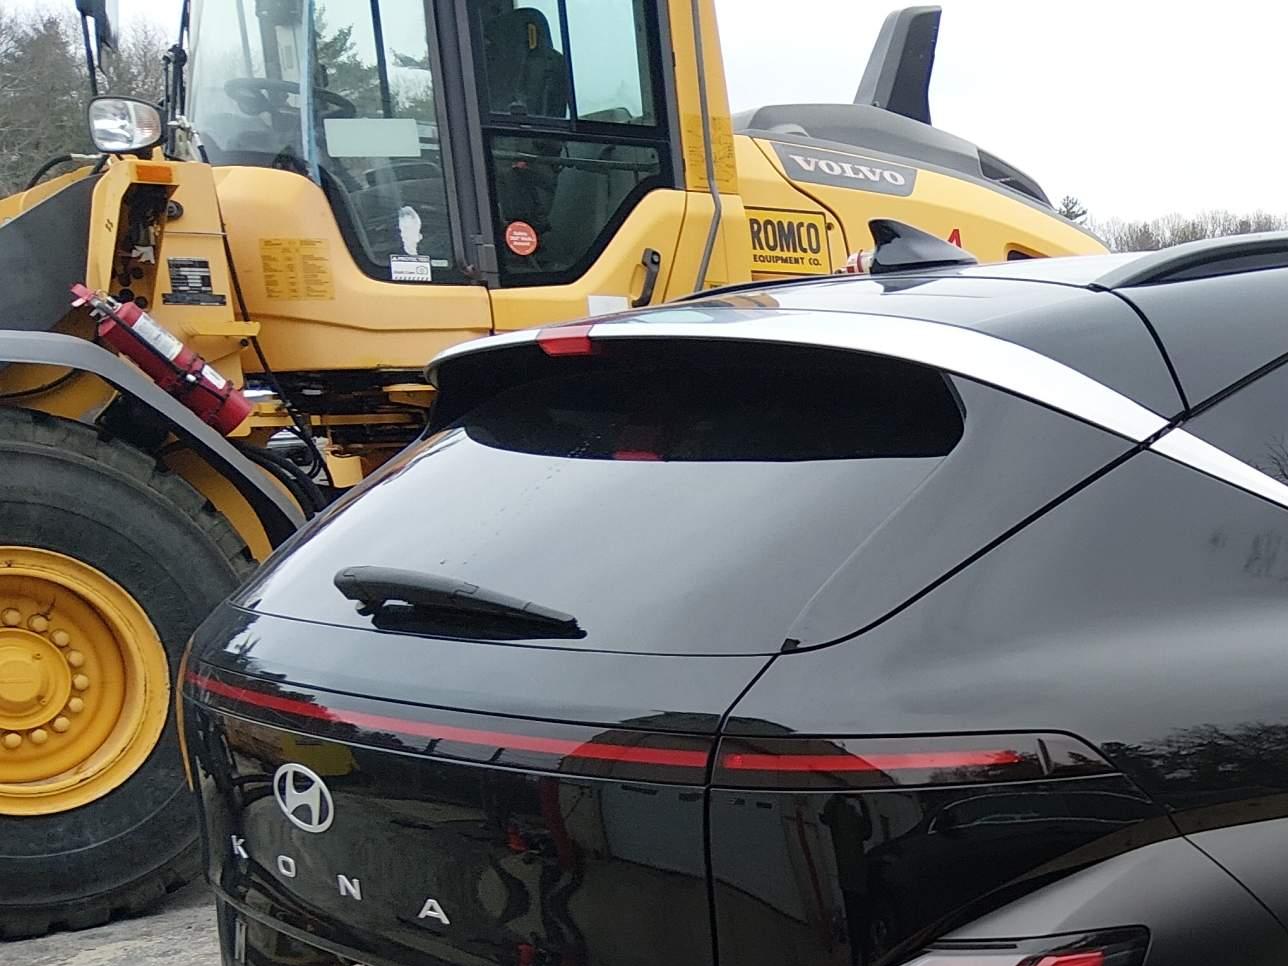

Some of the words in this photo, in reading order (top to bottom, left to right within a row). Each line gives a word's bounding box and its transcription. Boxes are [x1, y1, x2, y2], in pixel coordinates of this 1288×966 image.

[789, 154, 905, 186] VOLVO
[749, 218, 820, 254] ROMCO
[753, 254, 805, 265] EQUIPMENT
[808, 257, 822, 266] CO.
[231, 835, 450, 925] KONA
